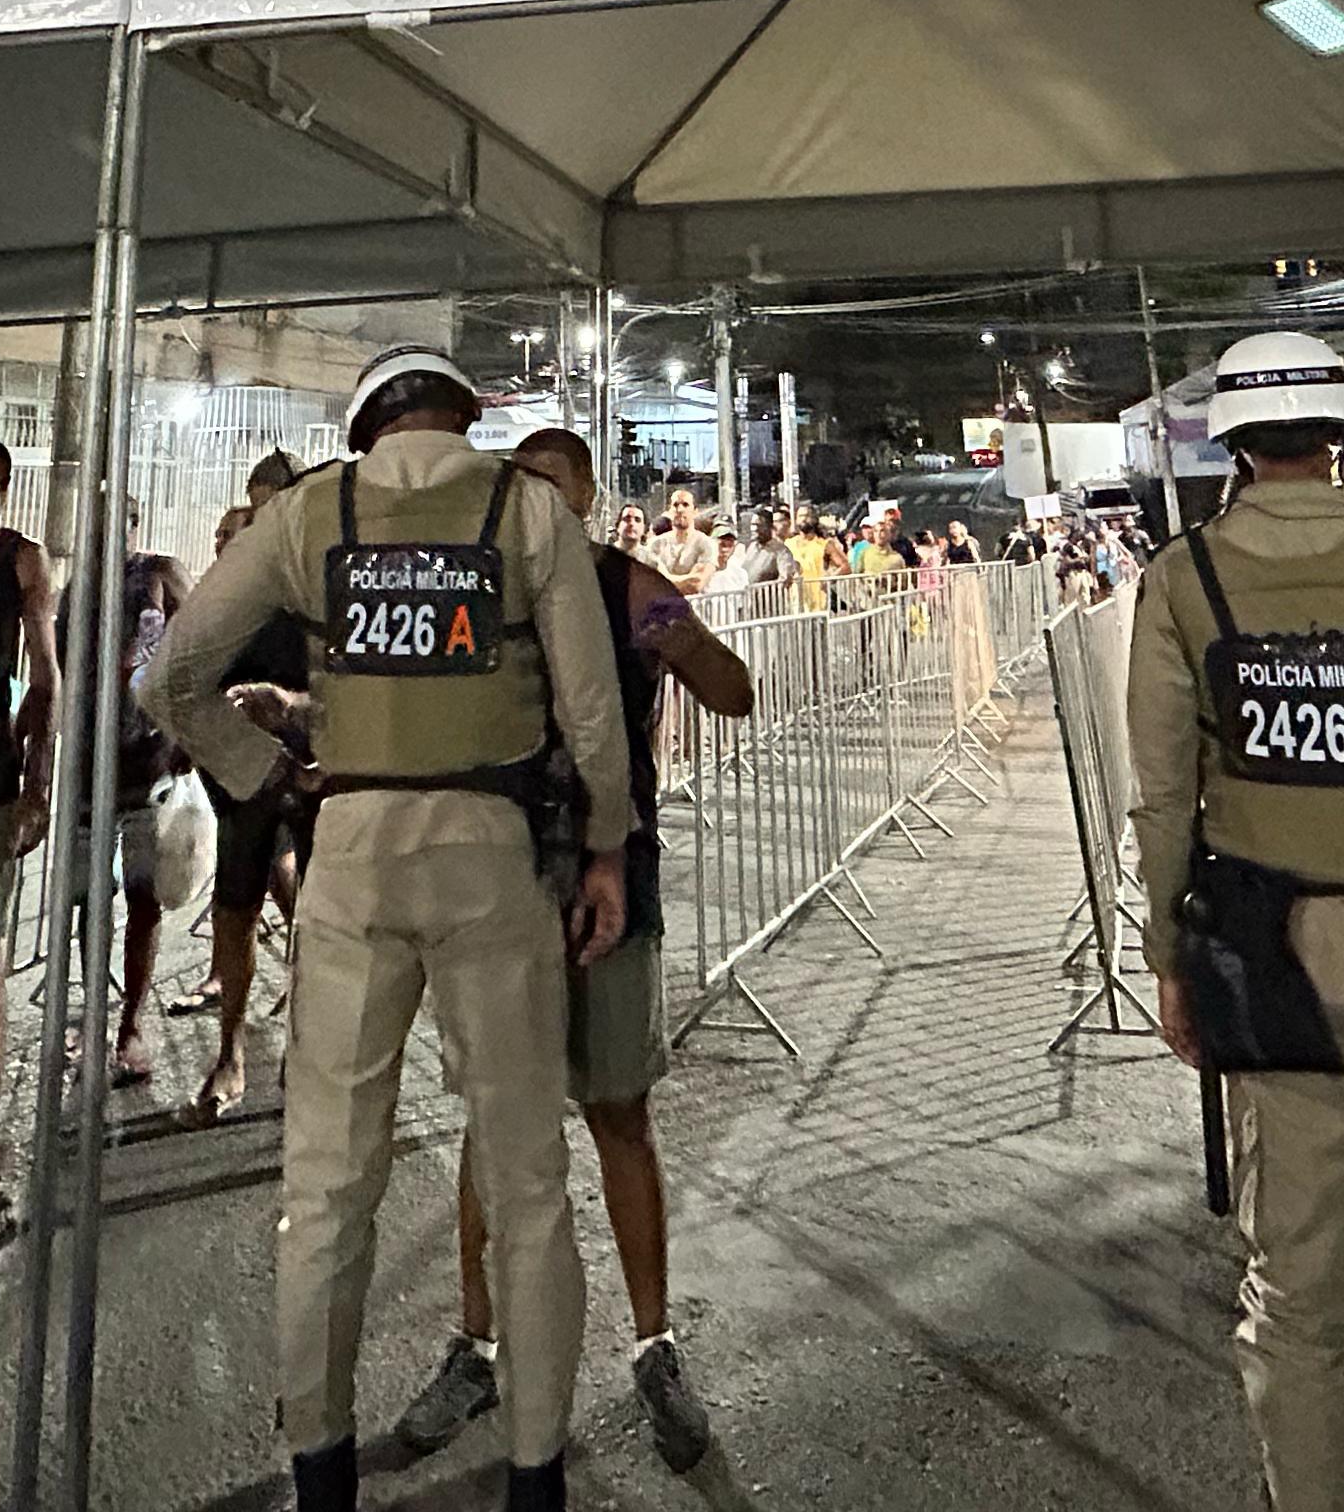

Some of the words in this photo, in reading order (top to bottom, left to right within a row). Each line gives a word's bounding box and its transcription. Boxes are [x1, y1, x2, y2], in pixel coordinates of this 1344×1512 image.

[416, 569, 479, 591] MILITAR
[345, 602, 436, 657] 2426
[444, 603, 476, 657] A
[1237, 659, 1316, 688] POLÍCIA
